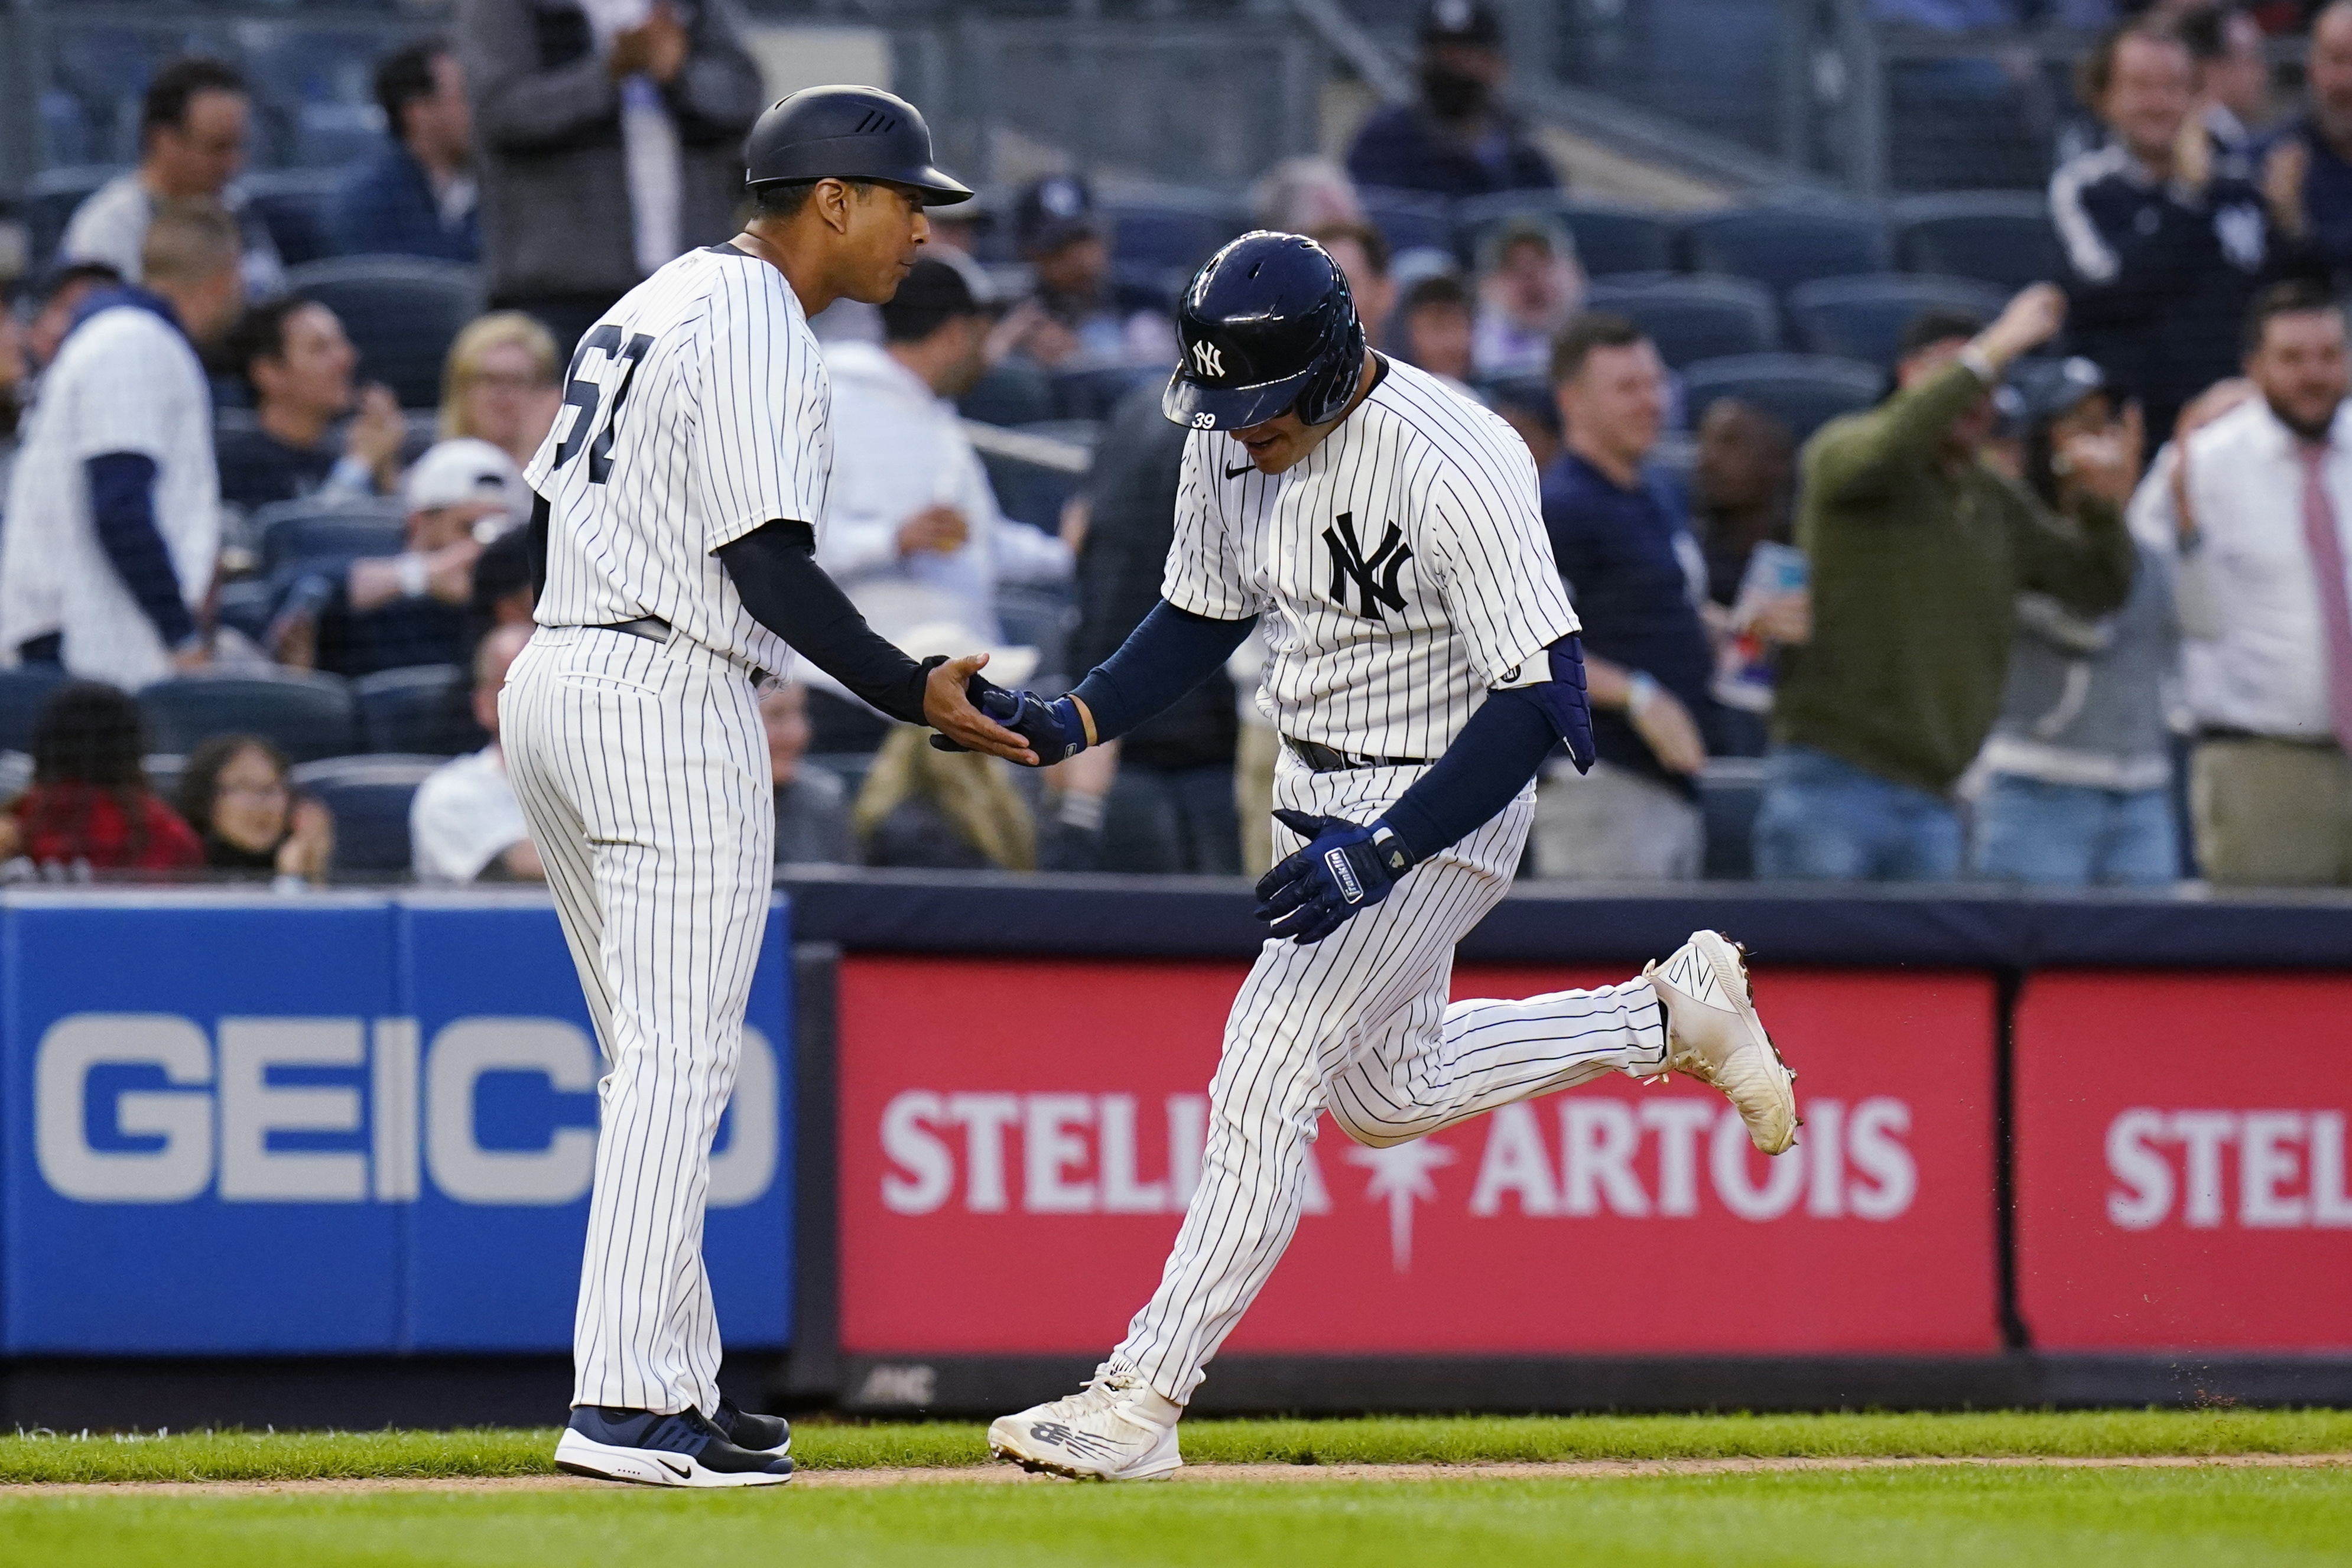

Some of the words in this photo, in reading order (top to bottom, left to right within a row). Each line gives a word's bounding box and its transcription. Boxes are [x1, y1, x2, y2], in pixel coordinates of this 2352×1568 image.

[1191, 412, 1216, 430] 39
[1322, 512, 1409, 621] NY
[1469, 1097, 1918, 1221] ARTOIS
